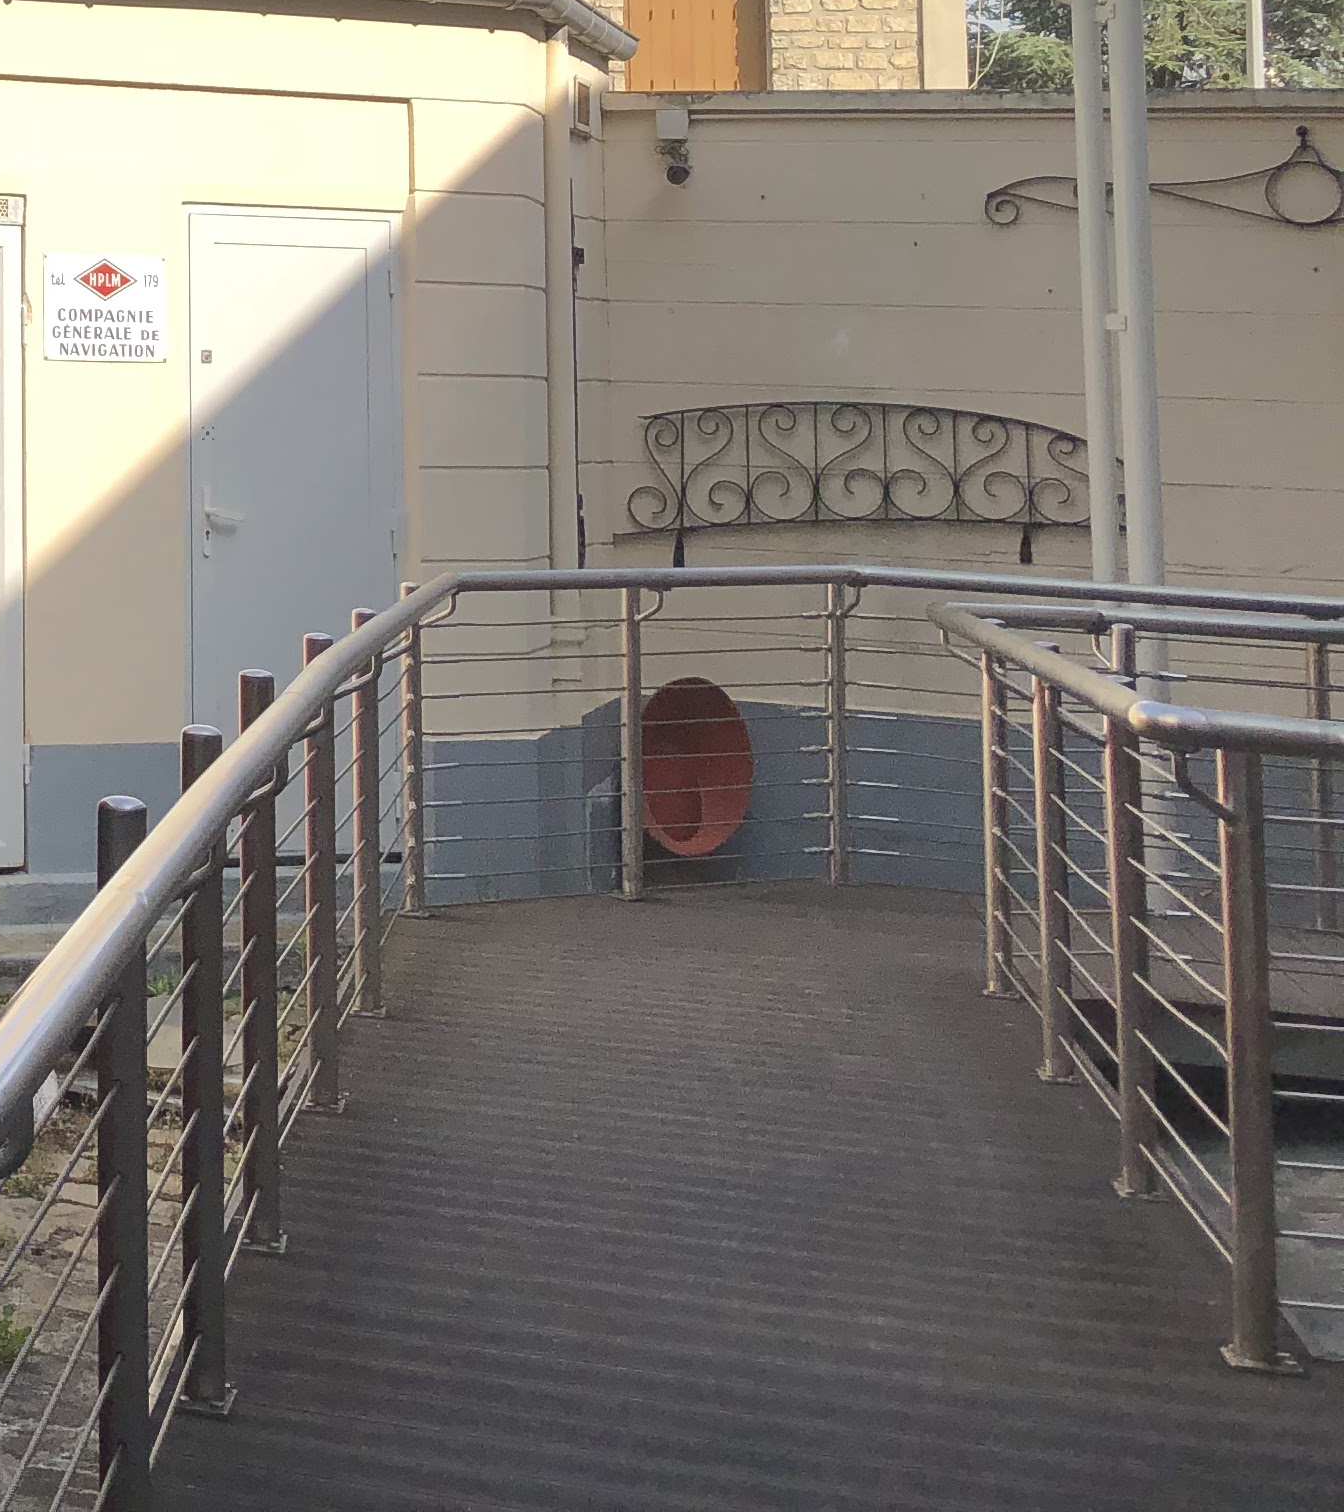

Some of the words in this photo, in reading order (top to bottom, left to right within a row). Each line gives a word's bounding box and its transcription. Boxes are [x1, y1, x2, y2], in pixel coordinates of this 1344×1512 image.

[89, 272, 121, 287] HPLM
[143, 274, 159, 287] 179
[57, 307, 154, 323] COMPAGNIE
[52, 324, 132, 340] GÉNÉRALE
[140, 329, 160, 341] DE
[59, 342, 155, 357] NAVIGATION
